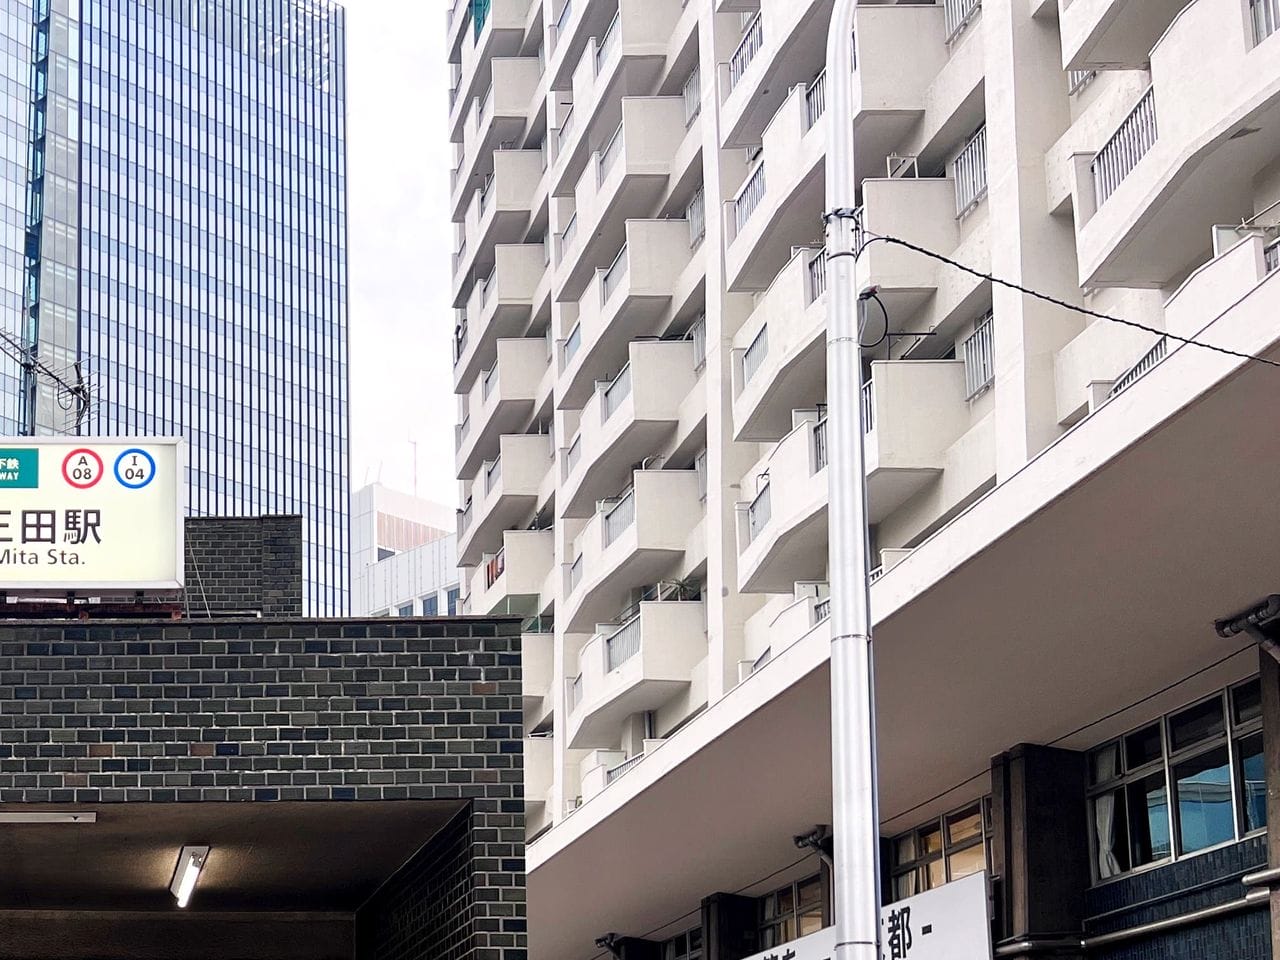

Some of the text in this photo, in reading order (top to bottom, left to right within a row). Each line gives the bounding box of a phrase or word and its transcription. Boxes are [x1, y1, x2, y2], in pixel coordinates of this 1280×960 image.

[78, 456, 88, 466] A
[72, 468, 92, 480] 08
[125, 468, 144, 480] 04
[47, 548, 85, 565] Sta.
